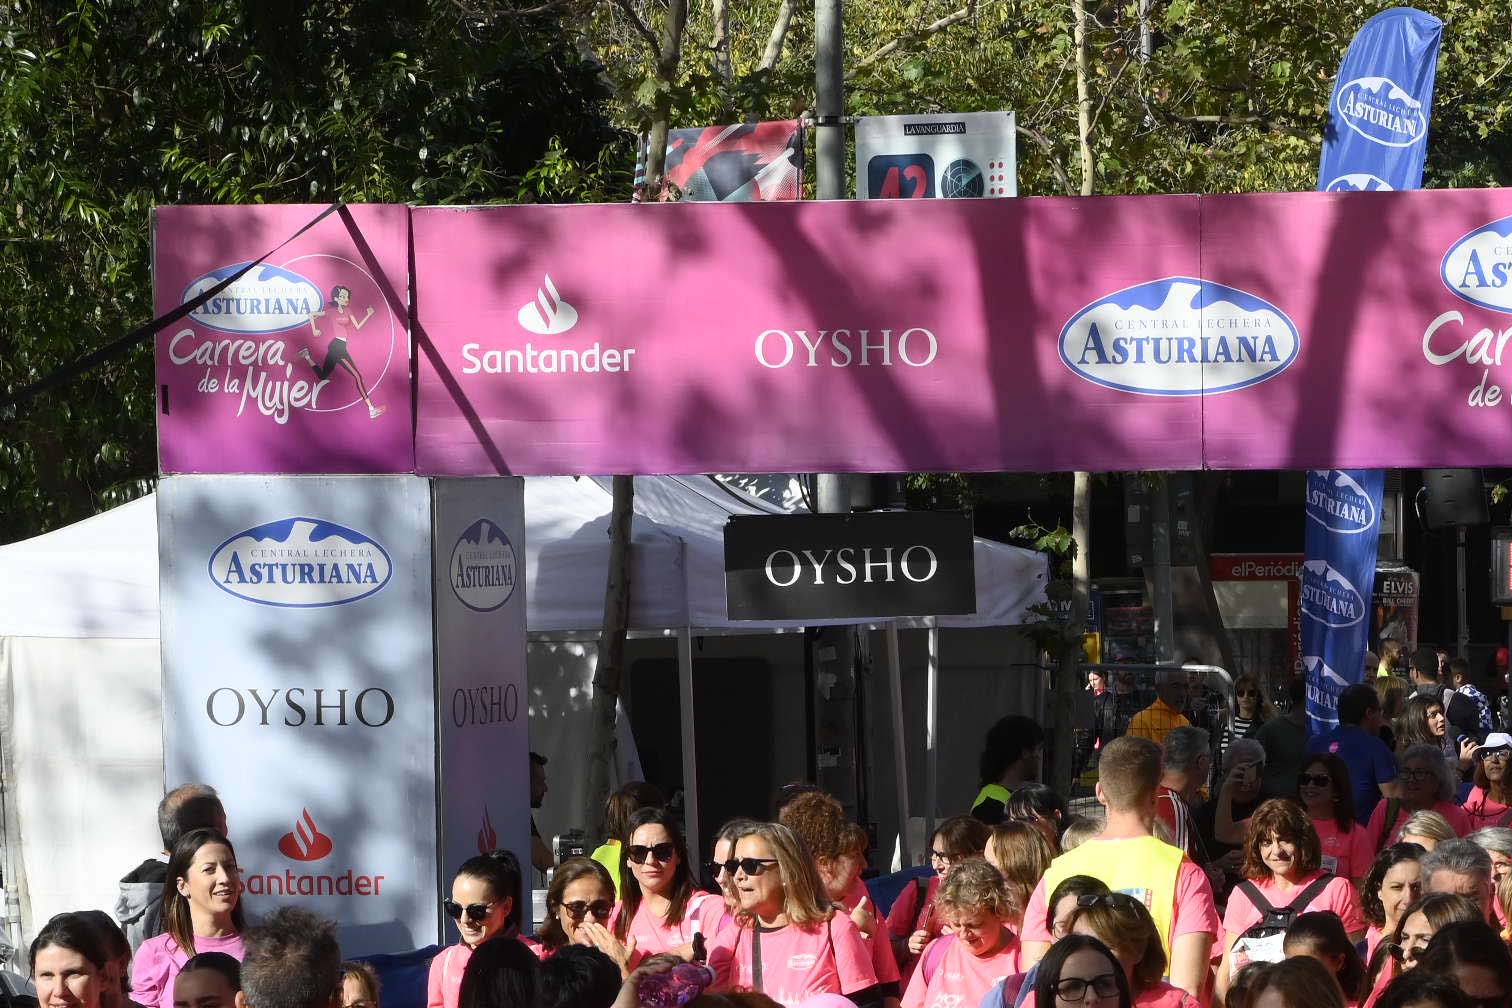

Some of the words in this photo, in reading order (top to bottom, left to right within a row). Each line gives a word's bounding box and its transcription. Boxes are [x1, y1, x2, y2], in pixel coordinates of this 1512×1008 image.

[1114, 319, 1189, 330] CENTRAL
[1199, 317, 1272, 328] LECHERA
[169, 330, 286, 366] Carrera
[463, 342, 636, 374] Santander
[754, 327, 938, 368] OYSHO
[1077, 321, 1280, 366] ASTURIANA
[197, 374, 219, 394] de
[220, 373, 240, 395] la
[237, 362, 331, 425] Mujer
[1468, 369, 1502, 409] de
[223, 551, 379, 585] ASTURIANA
[250, 549, 309, 558] CENTRAL
[314, 548, 373, 557] LECHERA
[455, 553, 513, 589] ASTURIANA
[764, 544, 938, 587] OYSHO
[1383, 581, 1414, 593] ELVIS
[206, 687, 396, 728] OYSHO
[453, 683, 519, 729] OYSHO
